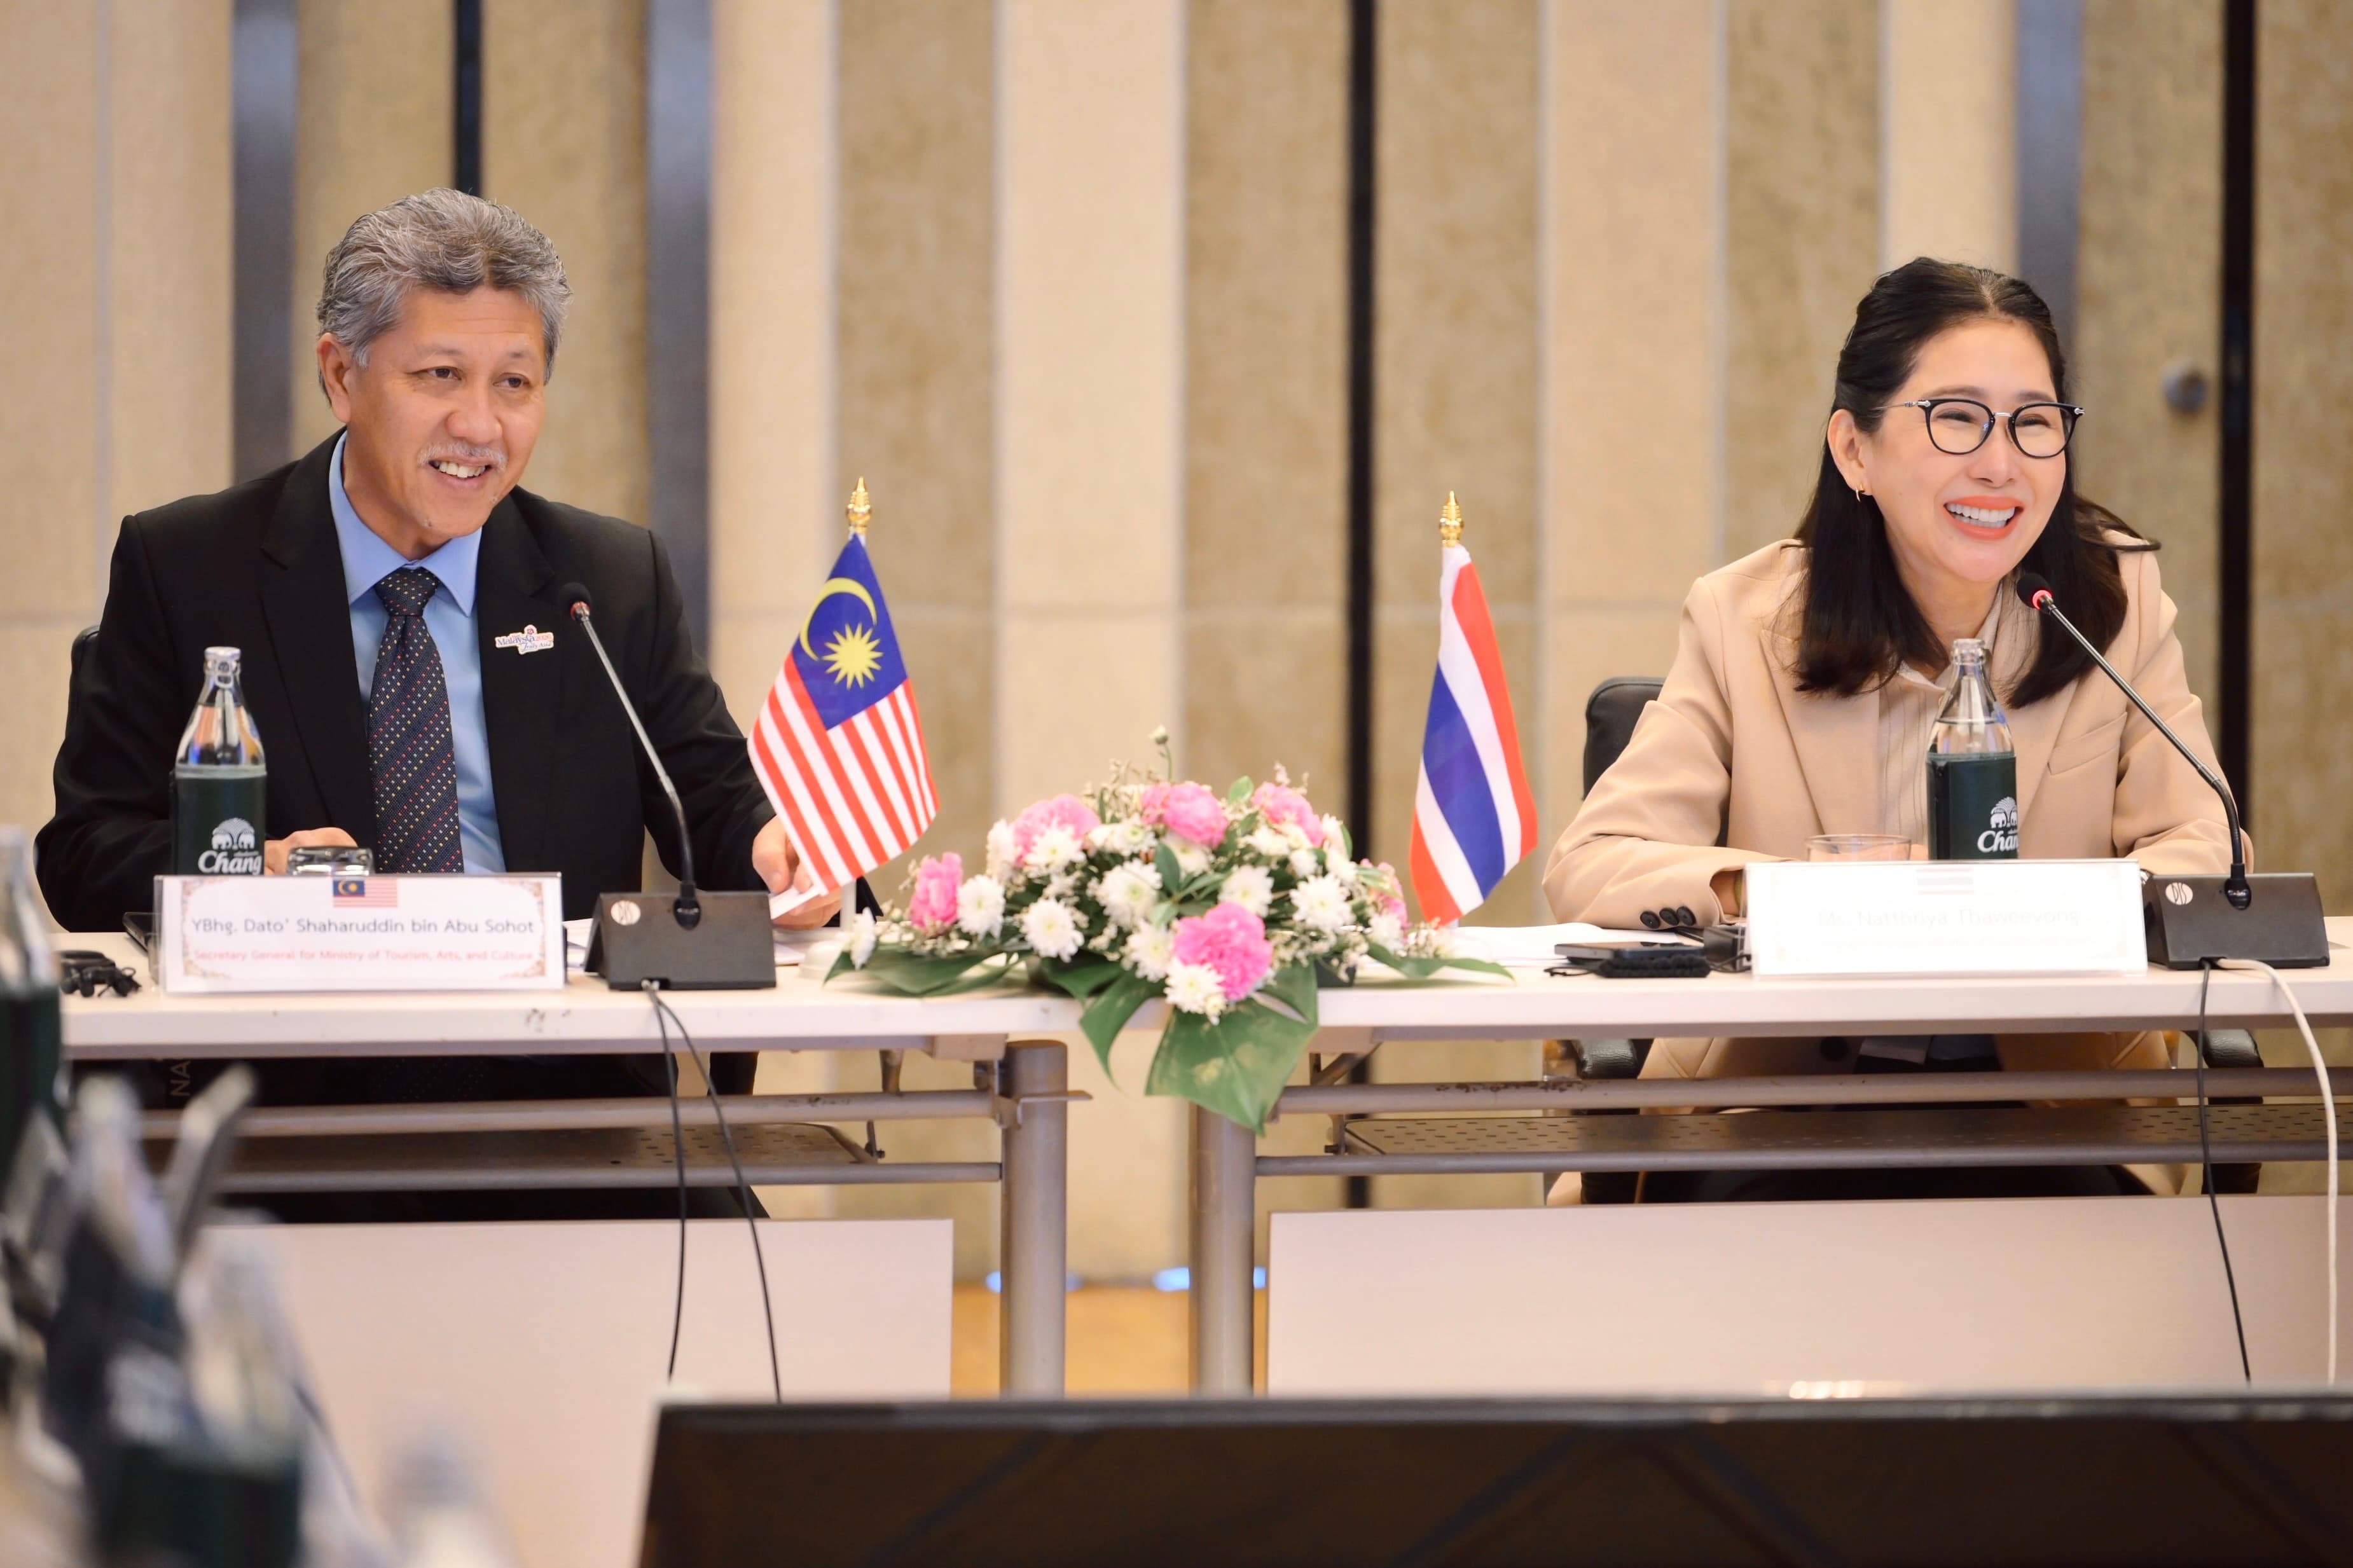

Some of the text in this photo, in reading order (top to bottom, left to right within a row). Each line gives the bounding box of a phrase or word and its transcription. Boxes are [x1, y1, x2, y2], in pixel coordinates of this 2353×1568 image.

[498, 635, 535, 646] Malaysia
[1977, 830, 2019, 853] Chan
[198, 850, 263, 876] Chang
[192, 918, 237, 936] YBhg.
[296, 918, 404, 933] Shaharuddin
[411, 919, 438, 933] bin
[445, 919, 478, 933] Abu
[485, 919, 534, 933] Sohot
[193, 951, 246, 961] Secretary
[251, 951, 294, 960] General
[300, 951, 315, 960] for
[320, 951, 363, 961] Ministry
[368, 950, 380, 961] of
[466, 951, 487, 959] and
